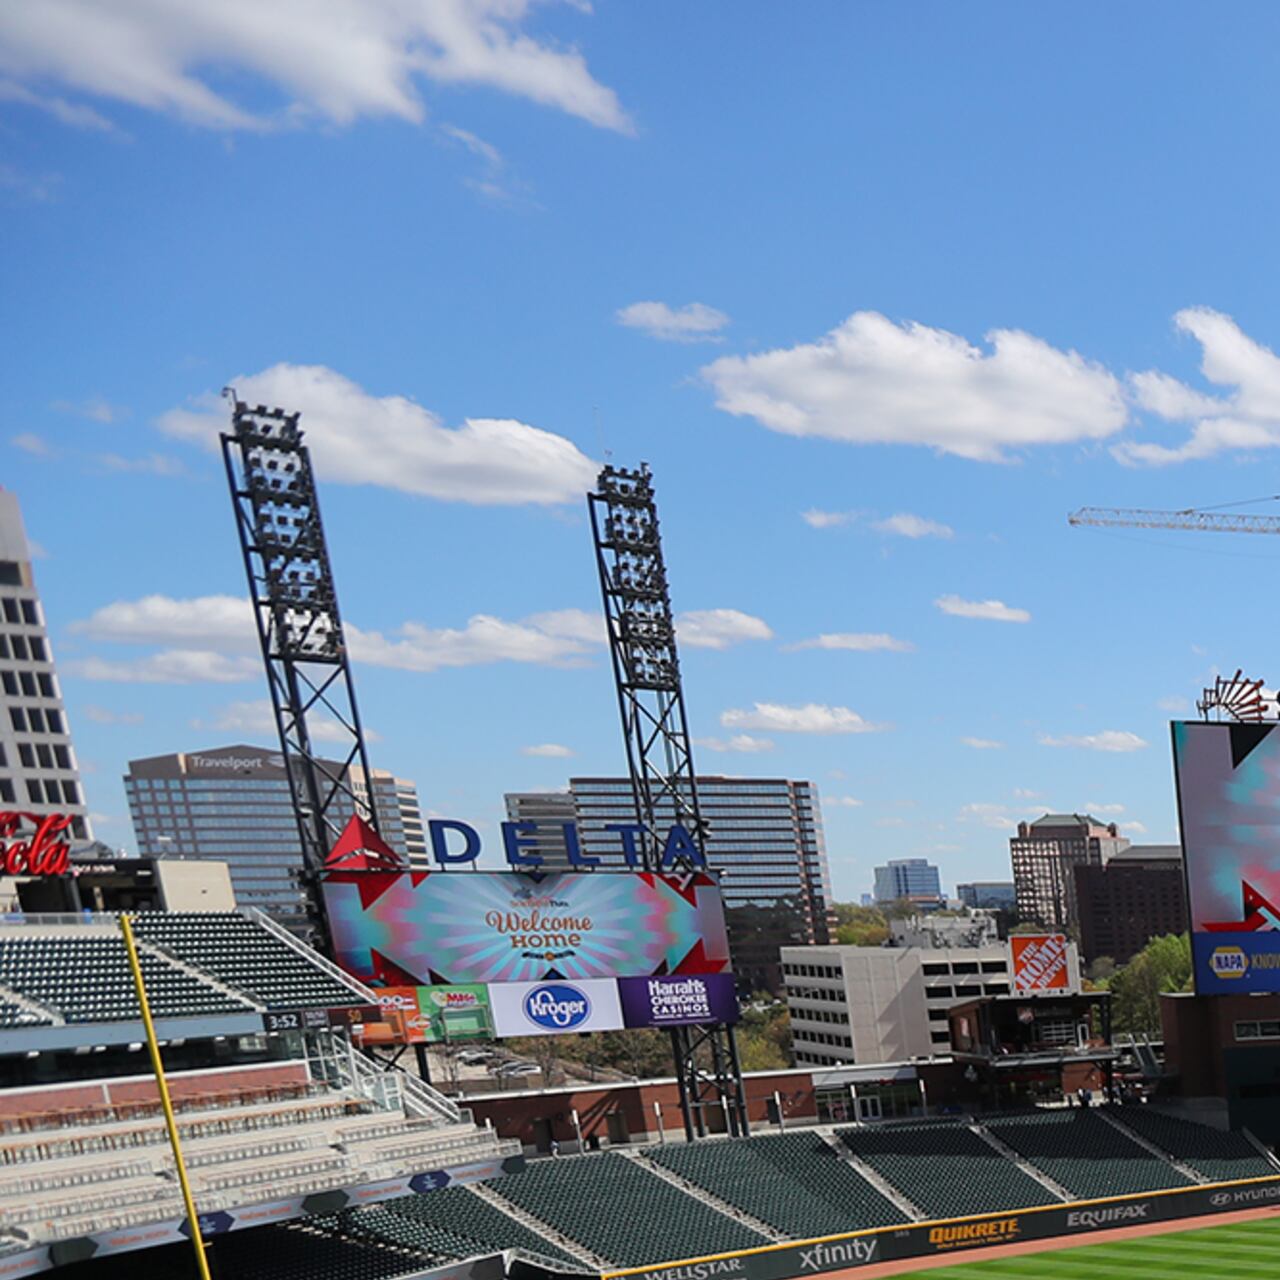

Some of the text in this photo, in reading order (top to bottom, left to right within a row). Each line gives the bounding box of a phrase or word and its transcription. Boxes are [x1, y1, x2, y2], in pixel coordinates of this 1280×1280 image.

[191, 755, 263, 770] Travelport
[428, 819, 702, 866] DELTA
[485, 909, 593, 934] Welcome
[1015, 938, 1068, 989] HOME
[1018, 942, 1038, 962] THE
[1215, 952, 1245, 971] NAPA
[529, 989, 586, 1025] Kroger
[652, 1004, 709, 1015] CASINOS
[269, 1014, 298, 1029] 3:52
[1067, 1203, 1149, 1227] EQUIFAX
[929, 1218, 1020, 1244] QUIKRETE
[799, 1238, 877, 1270] xfinity
